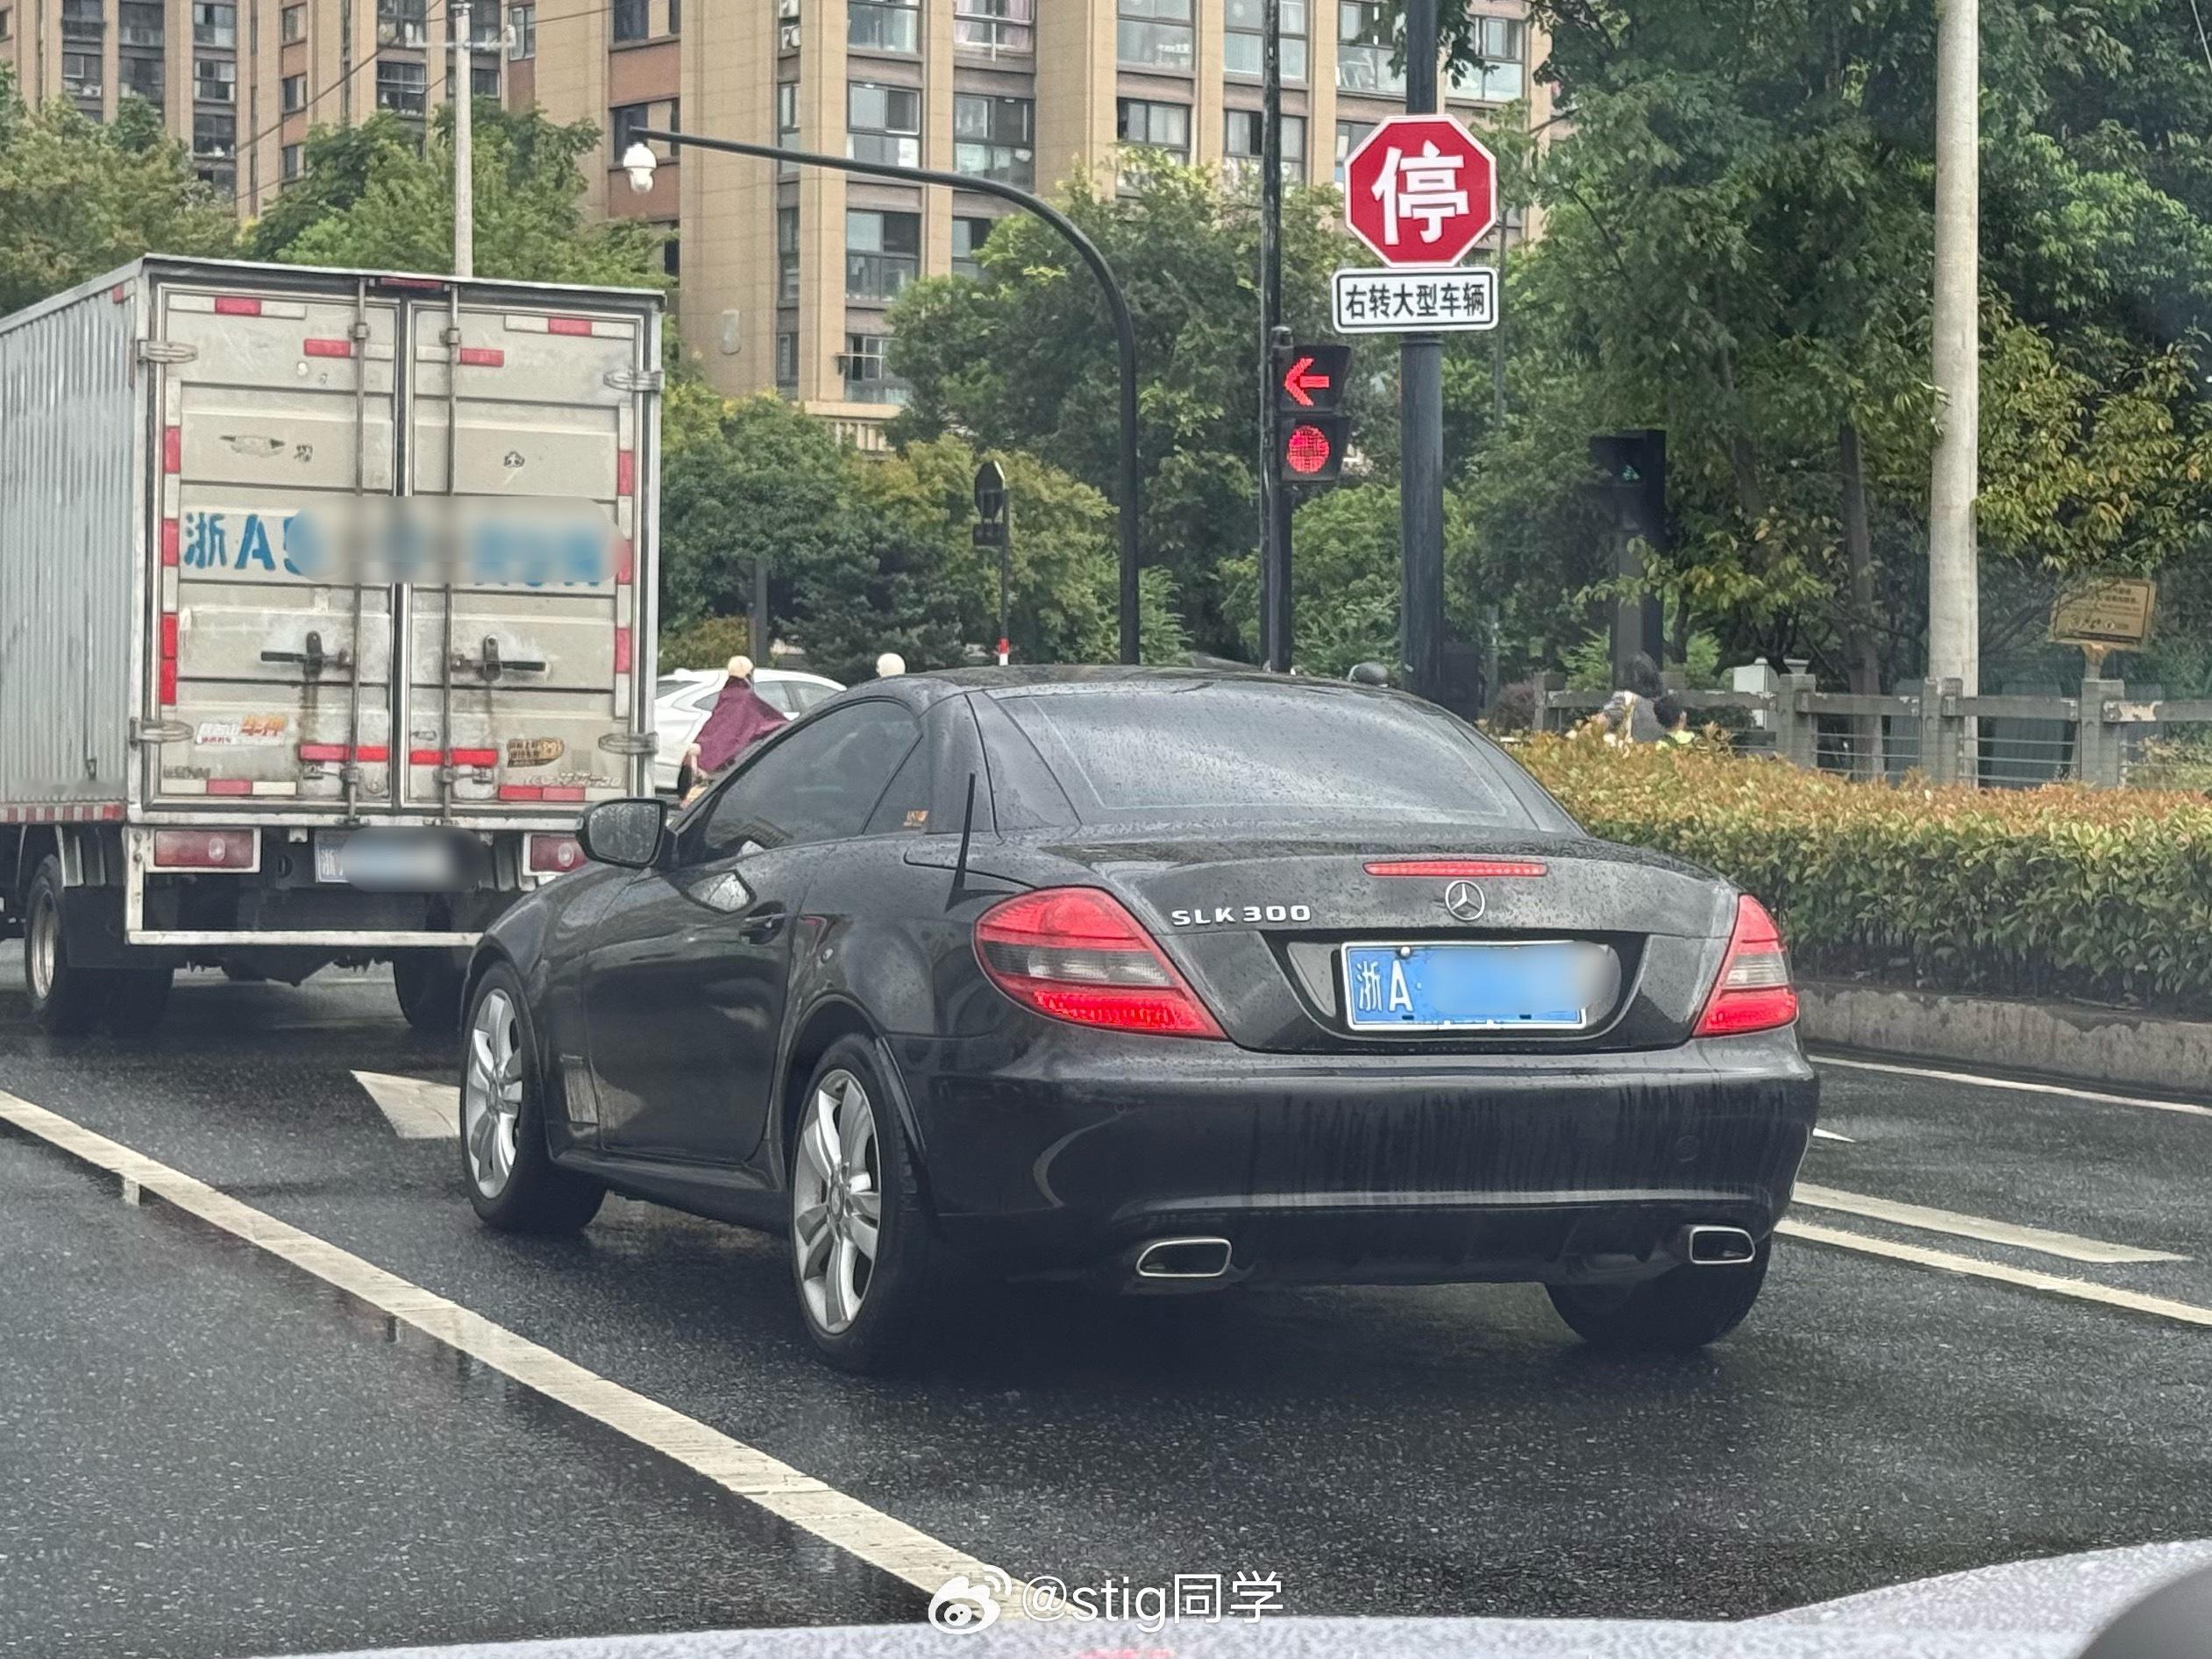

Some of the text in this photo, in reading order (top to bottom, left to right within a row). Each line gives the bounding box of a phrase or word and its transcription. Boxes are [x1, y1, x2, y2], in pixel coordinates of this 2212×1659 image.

[1370, 139, 1470, 246] 停
[1345, 281, 1485, 319] 右转大型车辆
[1171, 904, 1312, 926] SLK 300
